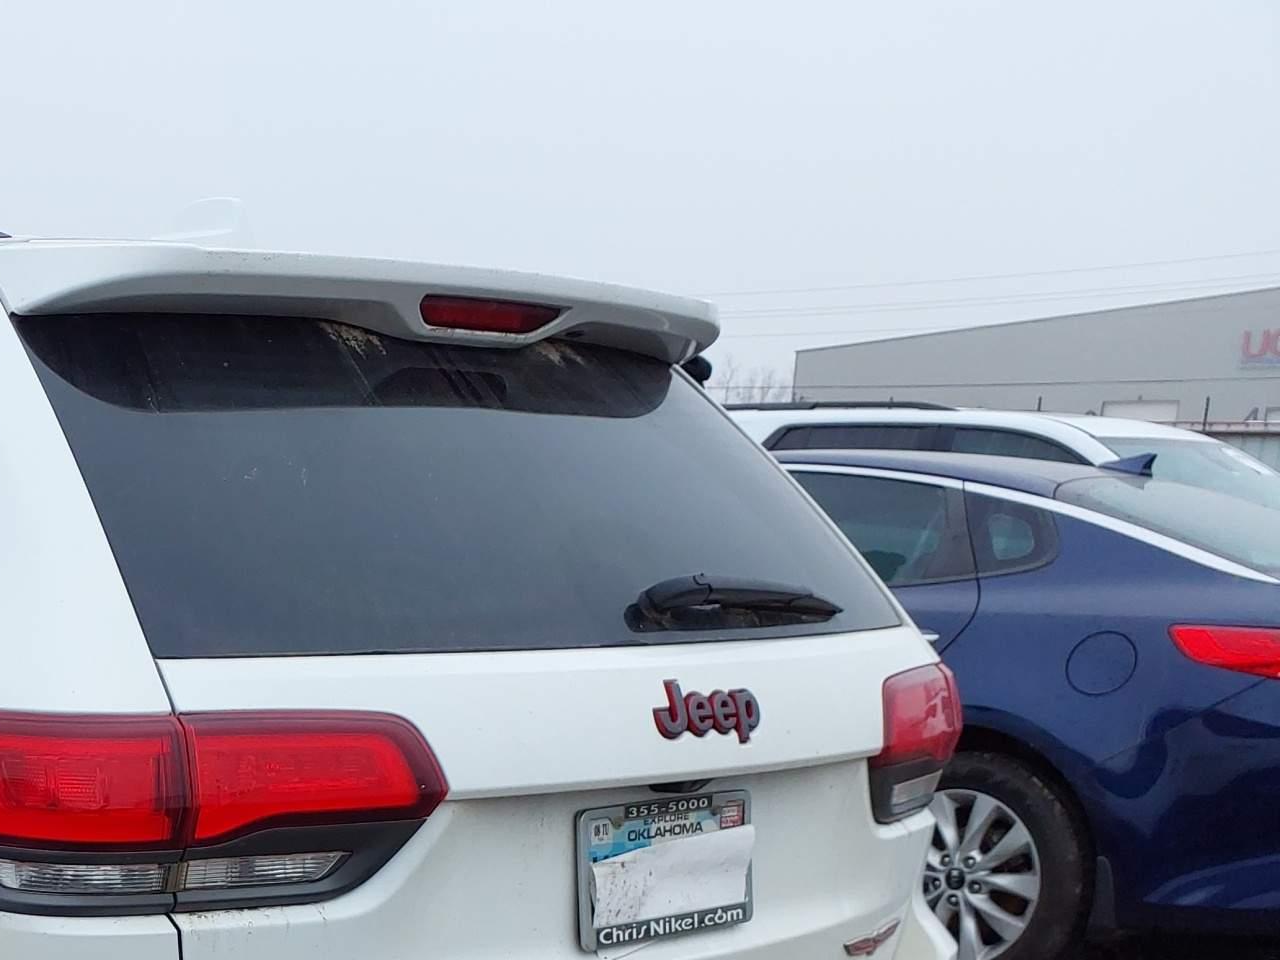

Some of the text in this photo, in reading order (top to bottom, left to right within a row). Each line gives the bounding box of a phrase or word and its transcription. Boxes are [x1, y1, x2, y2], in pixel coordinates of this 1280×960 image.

[652, 679, 760, 744] Jeep
[628, 797, 709, 817] 355-5000
[643, 812, 691, 826] EXPLORE
[627, 821, 704, 842] OKLAHOMA
